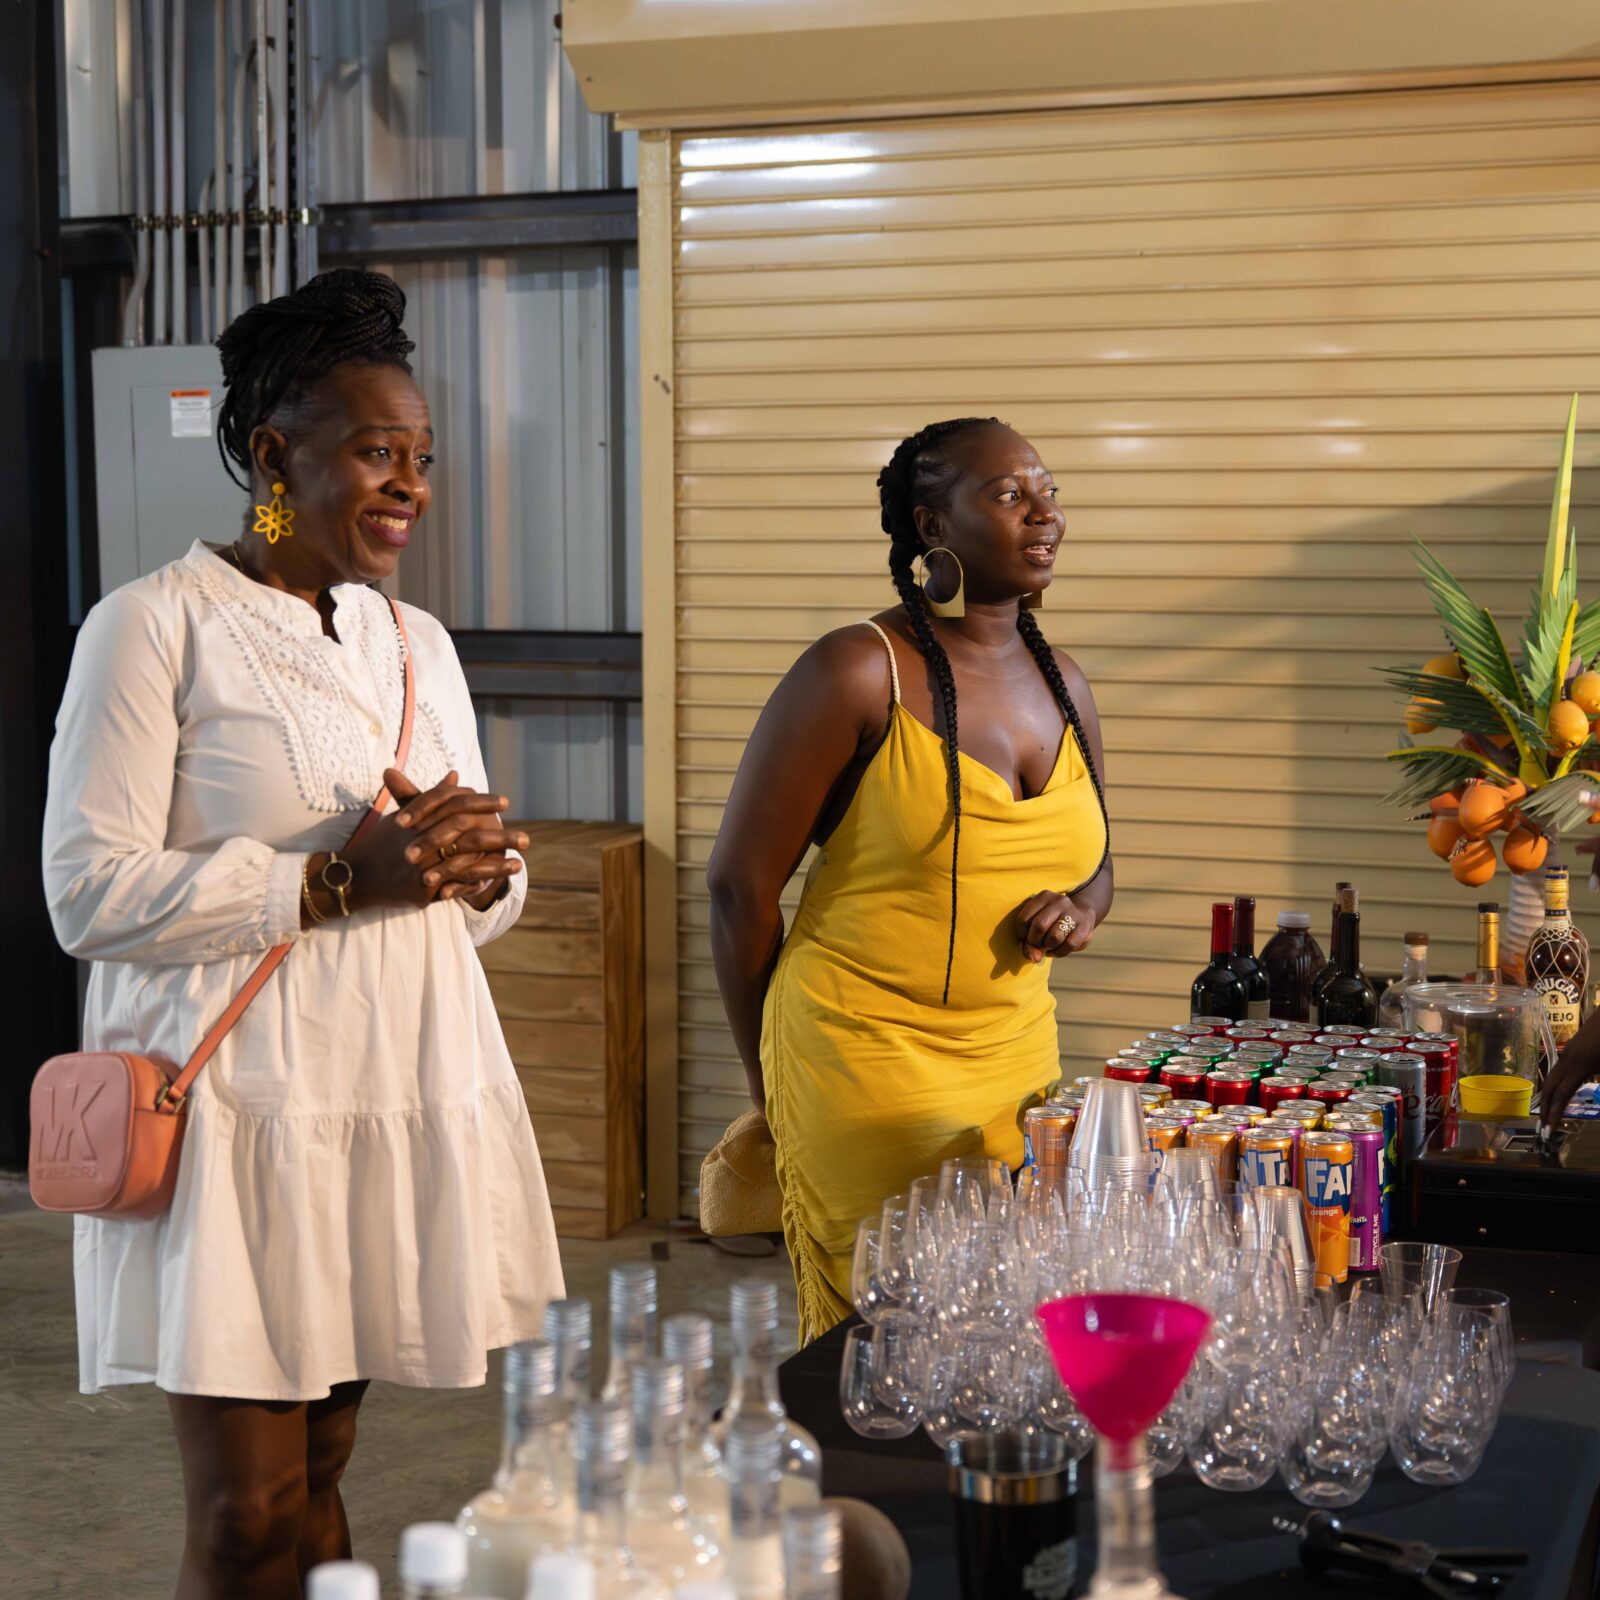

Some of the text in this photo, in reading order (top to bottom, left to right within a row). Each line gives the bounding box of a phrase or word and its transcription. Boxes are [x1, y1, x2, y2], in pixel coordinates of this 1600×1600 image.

[1533, 977, 1579, 1004] RUGAL
[1238, 1151, 1291, 1187] NTA
[1310, 1208, 1339, 1217] orange
